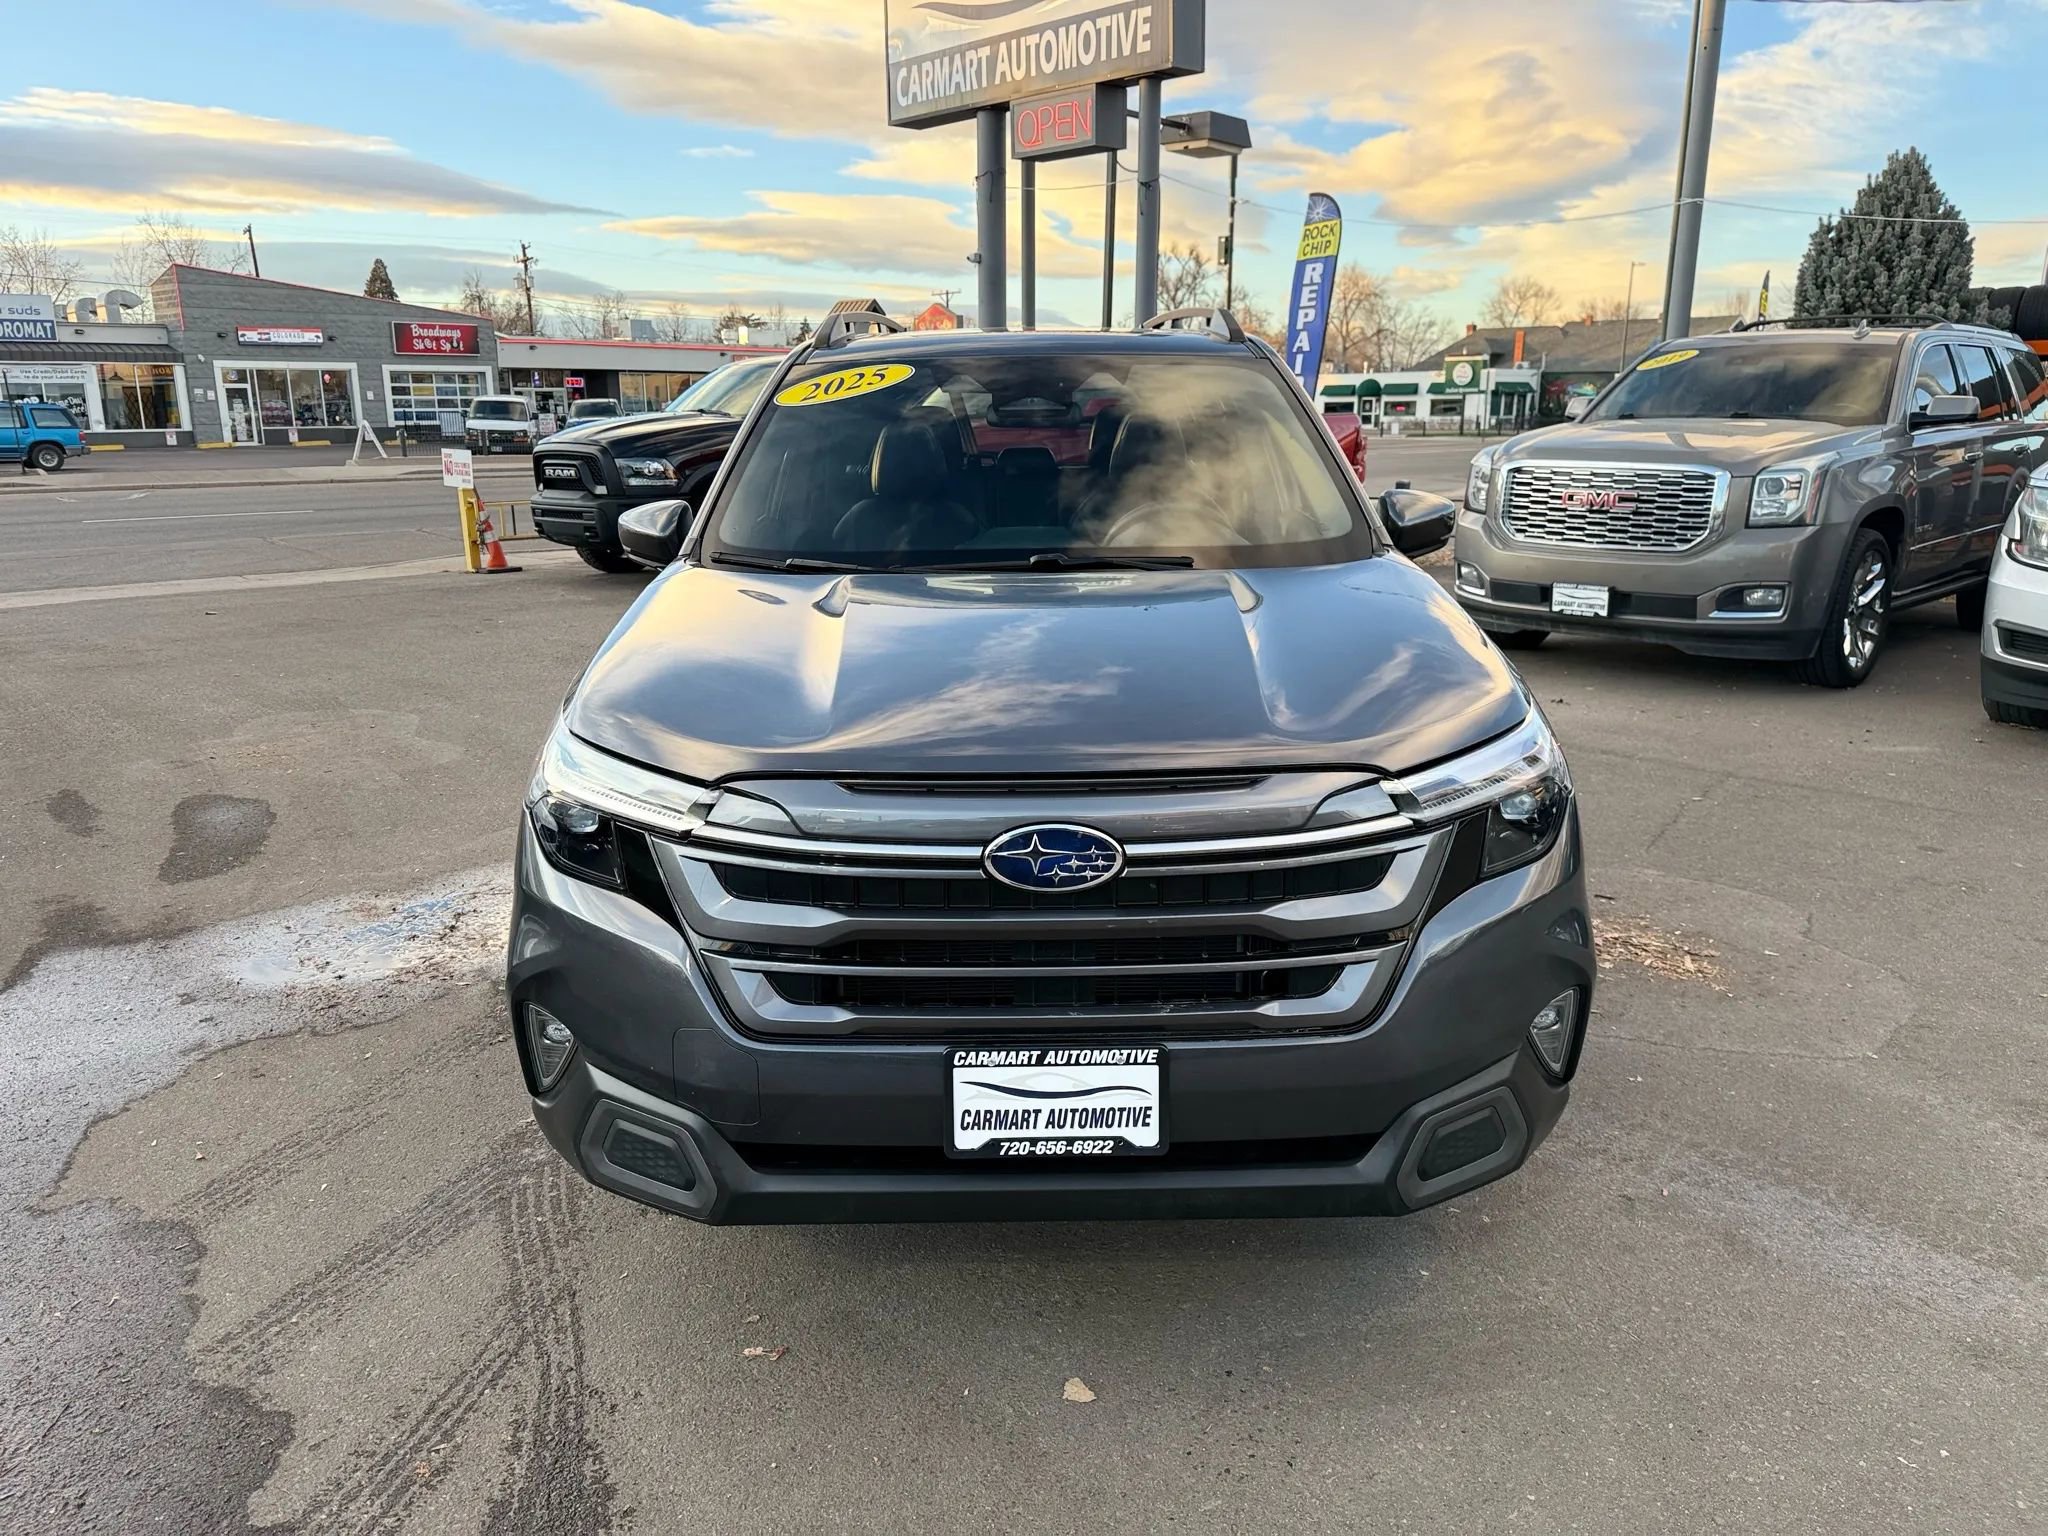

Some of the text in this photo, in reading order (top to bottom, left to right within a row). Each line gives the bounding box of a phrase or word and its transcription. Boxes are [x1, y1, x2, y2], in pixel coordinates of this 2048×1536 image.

[896, 5, 1153, 108] CARMART AUTOMOTIVE
[1017, 99, 1093, 149] OPEN
[1302, 222, 1338, 243] ROCK
[1302, 239, 1332, 257] CHIP
[8, 306, 42, 316] suds
[410, 324, 462, 338] Broadways
[1291, 262, 1324, 389] REPAI
[799, 366, 889, 403] 2025
[545, 469, 576, 478] RAM
[1562, 489, 1639, 510] GMC
[953, 1049, 1159, 1067] CARMART AUTOMOTIVE
[960, 1106, 1153, 1131] CARMART AUTOMOTIVE
[999, 1140, 1115, 1156] 720-656-6922
